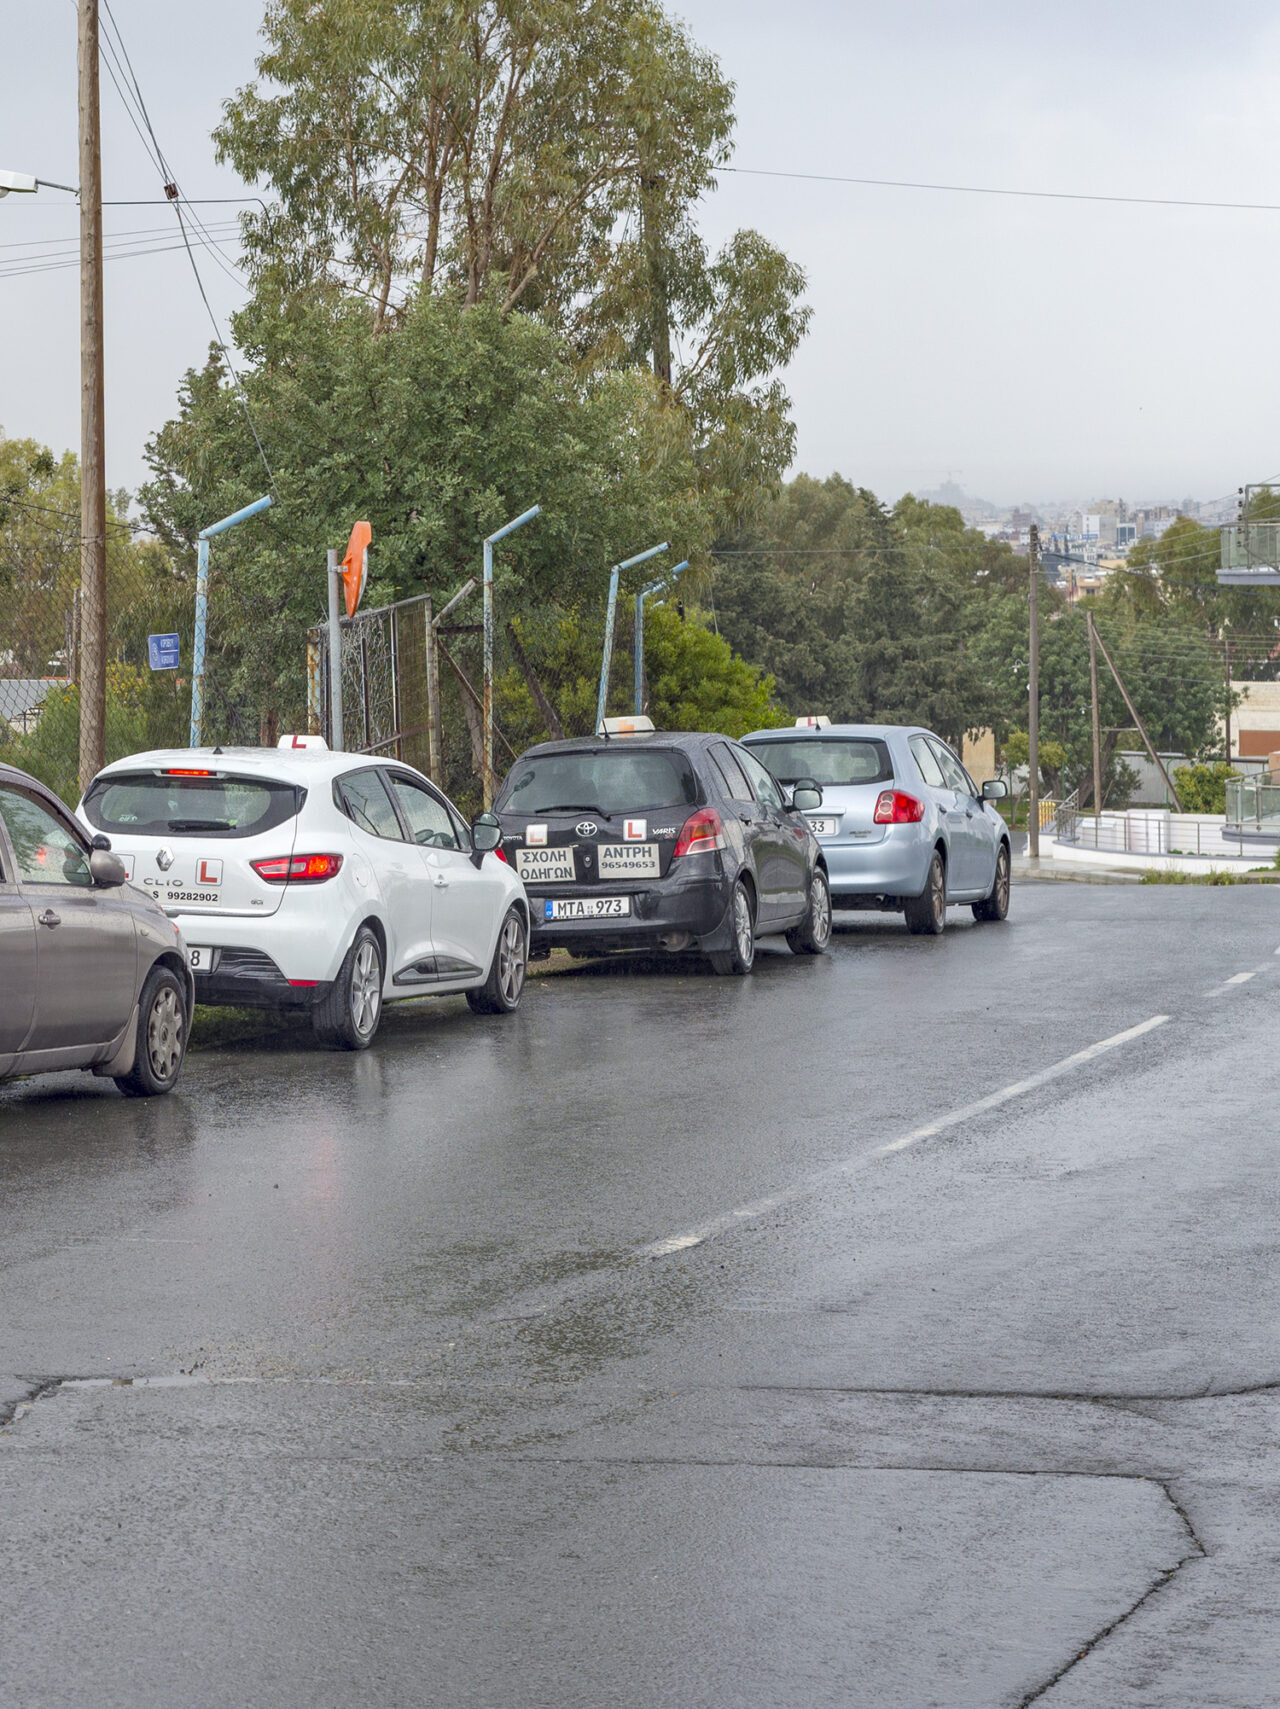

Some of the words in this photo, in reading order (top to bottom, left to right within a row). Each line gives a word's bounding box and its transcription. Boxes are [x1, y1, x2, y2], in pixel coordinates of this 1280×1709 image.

[291, 735, 307, 749] L
[628, 822, 643, 838] L
[522, 850, 567, 863] ΣΧΟΛΗ
[603, 846, 652, 859] ΑΝΤΡΗ
[601, 861, 656, 869] 96549653
[200, 861, 218, 883] L
[520, 867, 573, 880] ΟΔΗΓΩΝ
[167, 891, 219, 902] 99282902
[557, 901, 585, 915] MTA
[596, 899, 622, 914] 973
[190, 950, 201, 967] 8
